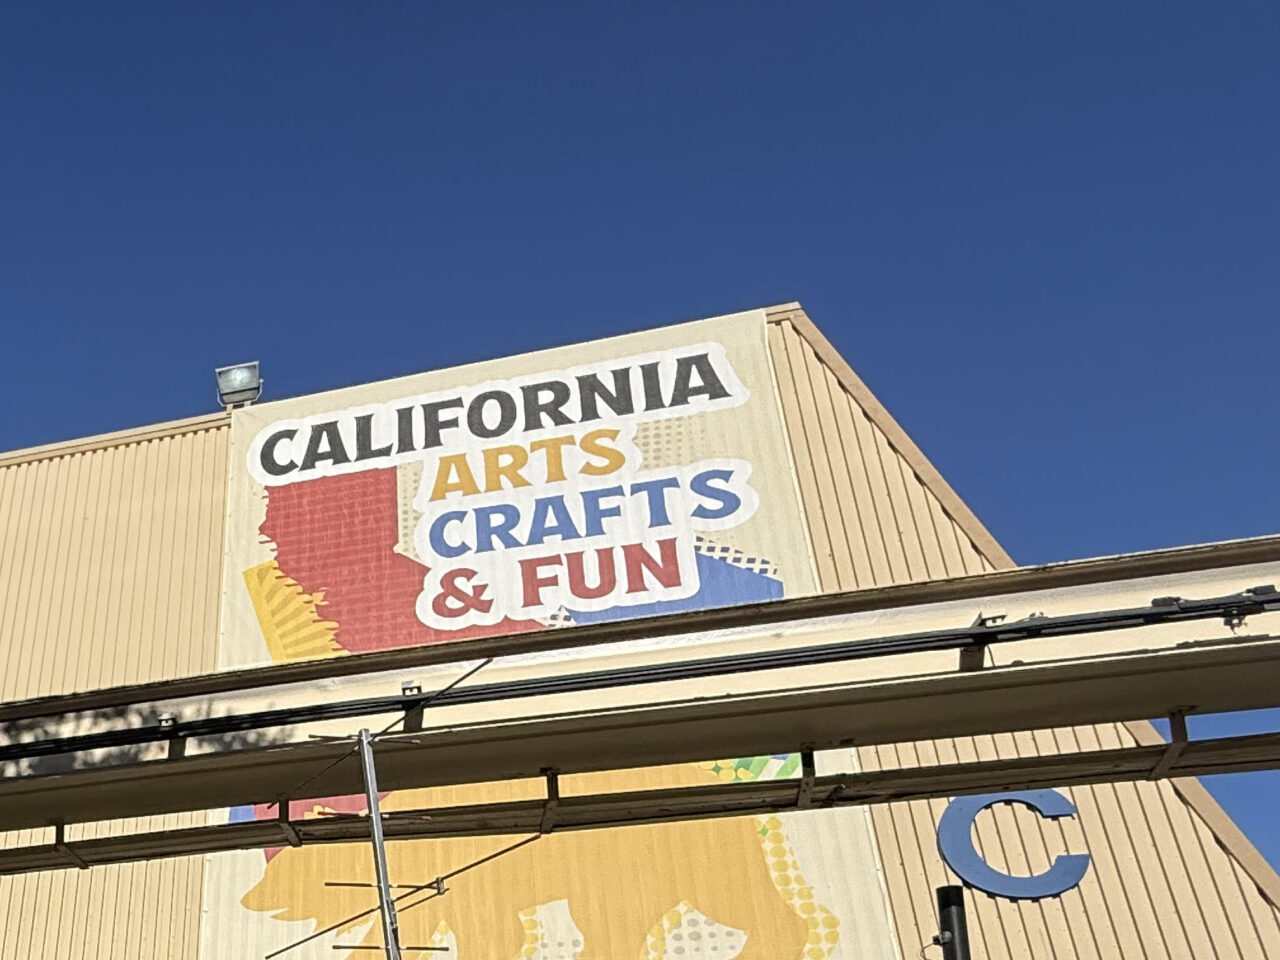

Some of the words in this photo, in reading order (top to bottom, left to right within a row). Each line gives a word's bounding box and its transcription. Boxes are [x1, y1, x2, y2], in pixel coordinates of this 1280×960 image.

[260, 353, 732, 477] CALIFORNIA
[429, 428, 627, 502] ARTS
[428, 469, 742, 559] CRAFTS
[432, 568, 495, 619] &
[520, 538, 683, 608] FUN
[937, 788, 1091, 900] C
